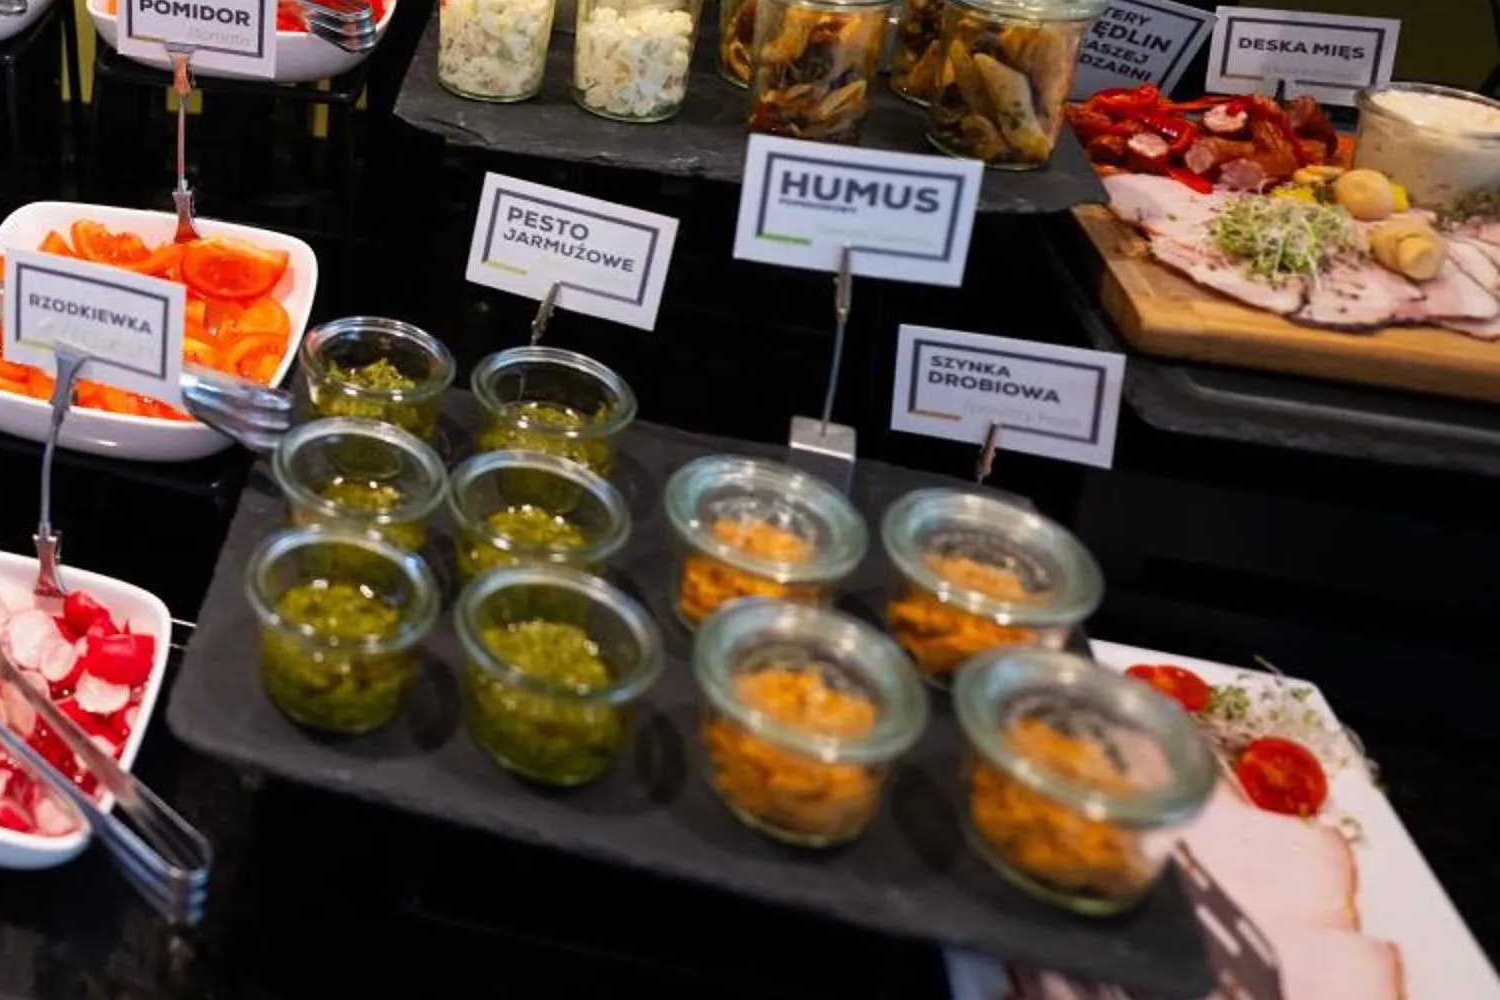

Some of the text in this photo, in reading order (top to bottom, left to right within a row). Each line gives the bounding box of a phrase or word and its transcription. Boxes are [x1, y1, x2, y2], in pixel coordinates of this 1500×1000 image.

[1102, 6, 1151, 26] TERY
[1087, 40, 1149, 64] ASZEJ
[1092, 20, 1172, 53] ĘDLIN
[1238, 37, 1365, 61] DESKA MIĘS
[1079, 54, 1152, 81] DZARNI
[781, 170, 940, 213] HUMUS
[507, 206, 589, 241] PESTO
[503, 228, 635, 273] JARMUŻOWE
[29, 293, 153, 335] RZODKIEWKA
[930, 355, 1010, 378] SZYNKA
[928, 370, 1061, 404] DROBIOWA
